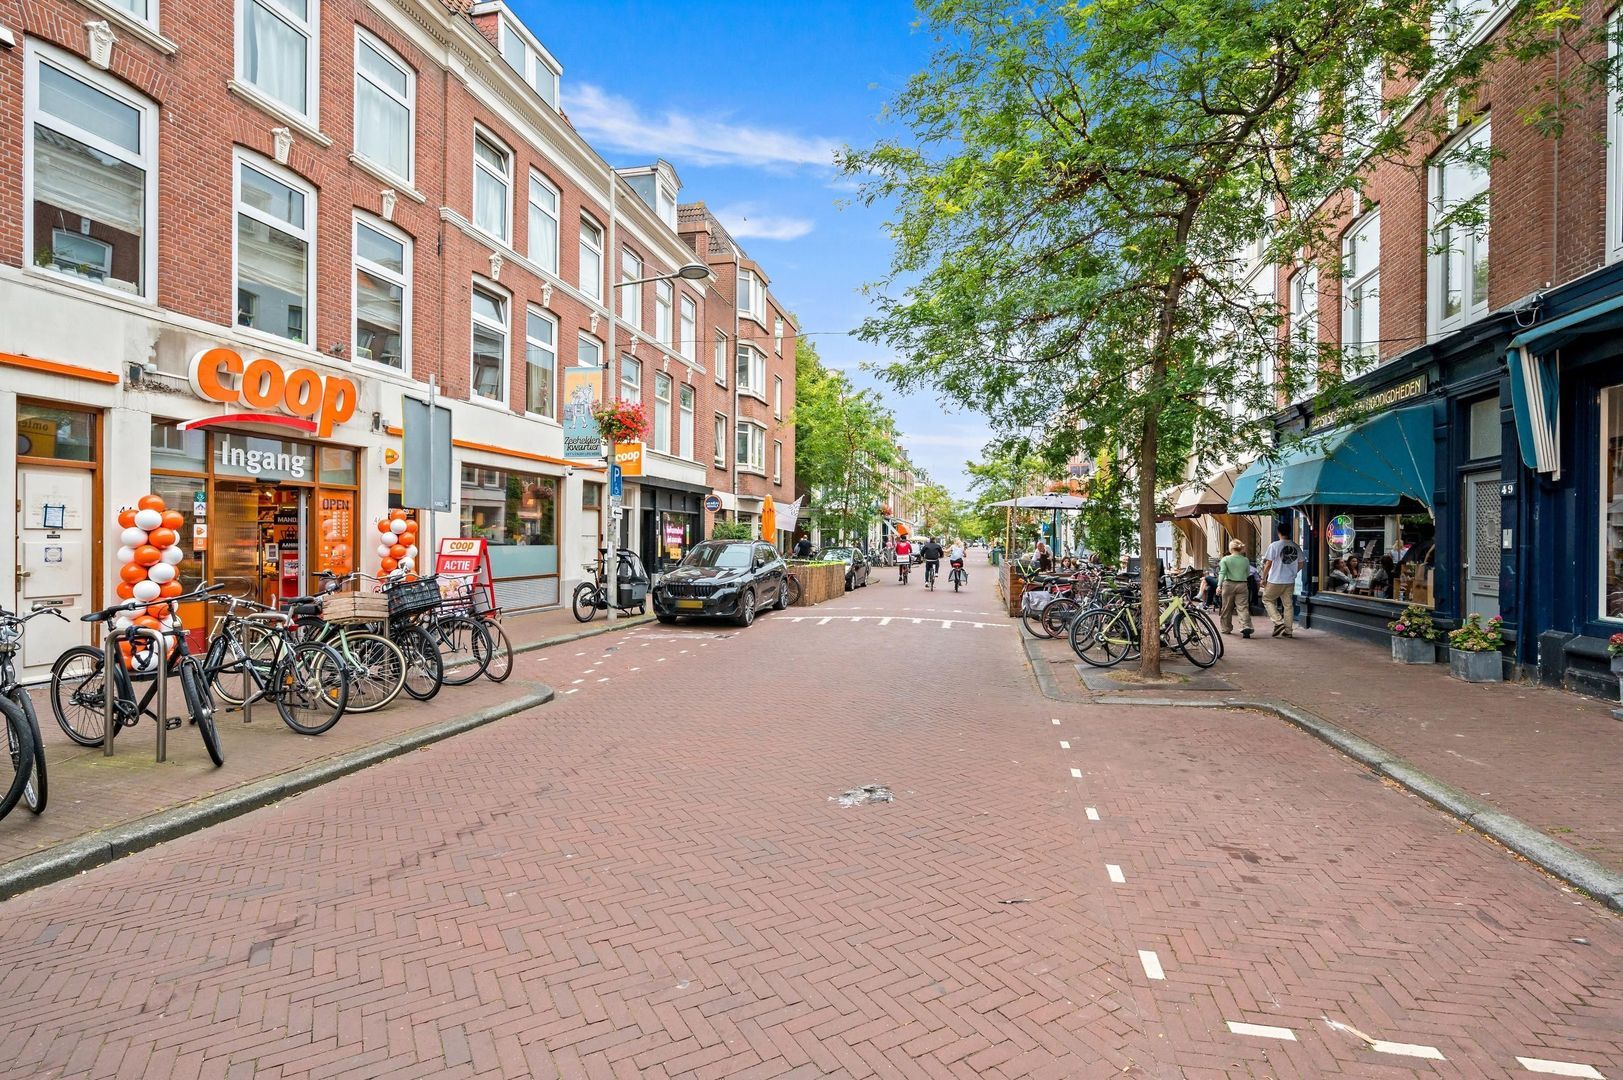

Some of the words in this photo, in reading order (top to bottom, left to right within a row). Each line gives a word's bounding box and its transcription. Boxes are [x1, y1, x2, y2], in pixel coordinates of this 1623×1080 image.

[194, 347, 357, 438] coop
[221, 440, 306, 478] Ingang
[615, 451, 640, 462] coop
[614, 467, 620, 482] P
[1501, 485, 1513, 494] 49
[322, 498, 349, 511] OPEN
[450, 541, 474, 553] coop
[443, 560, 471, 571] ACTIE
